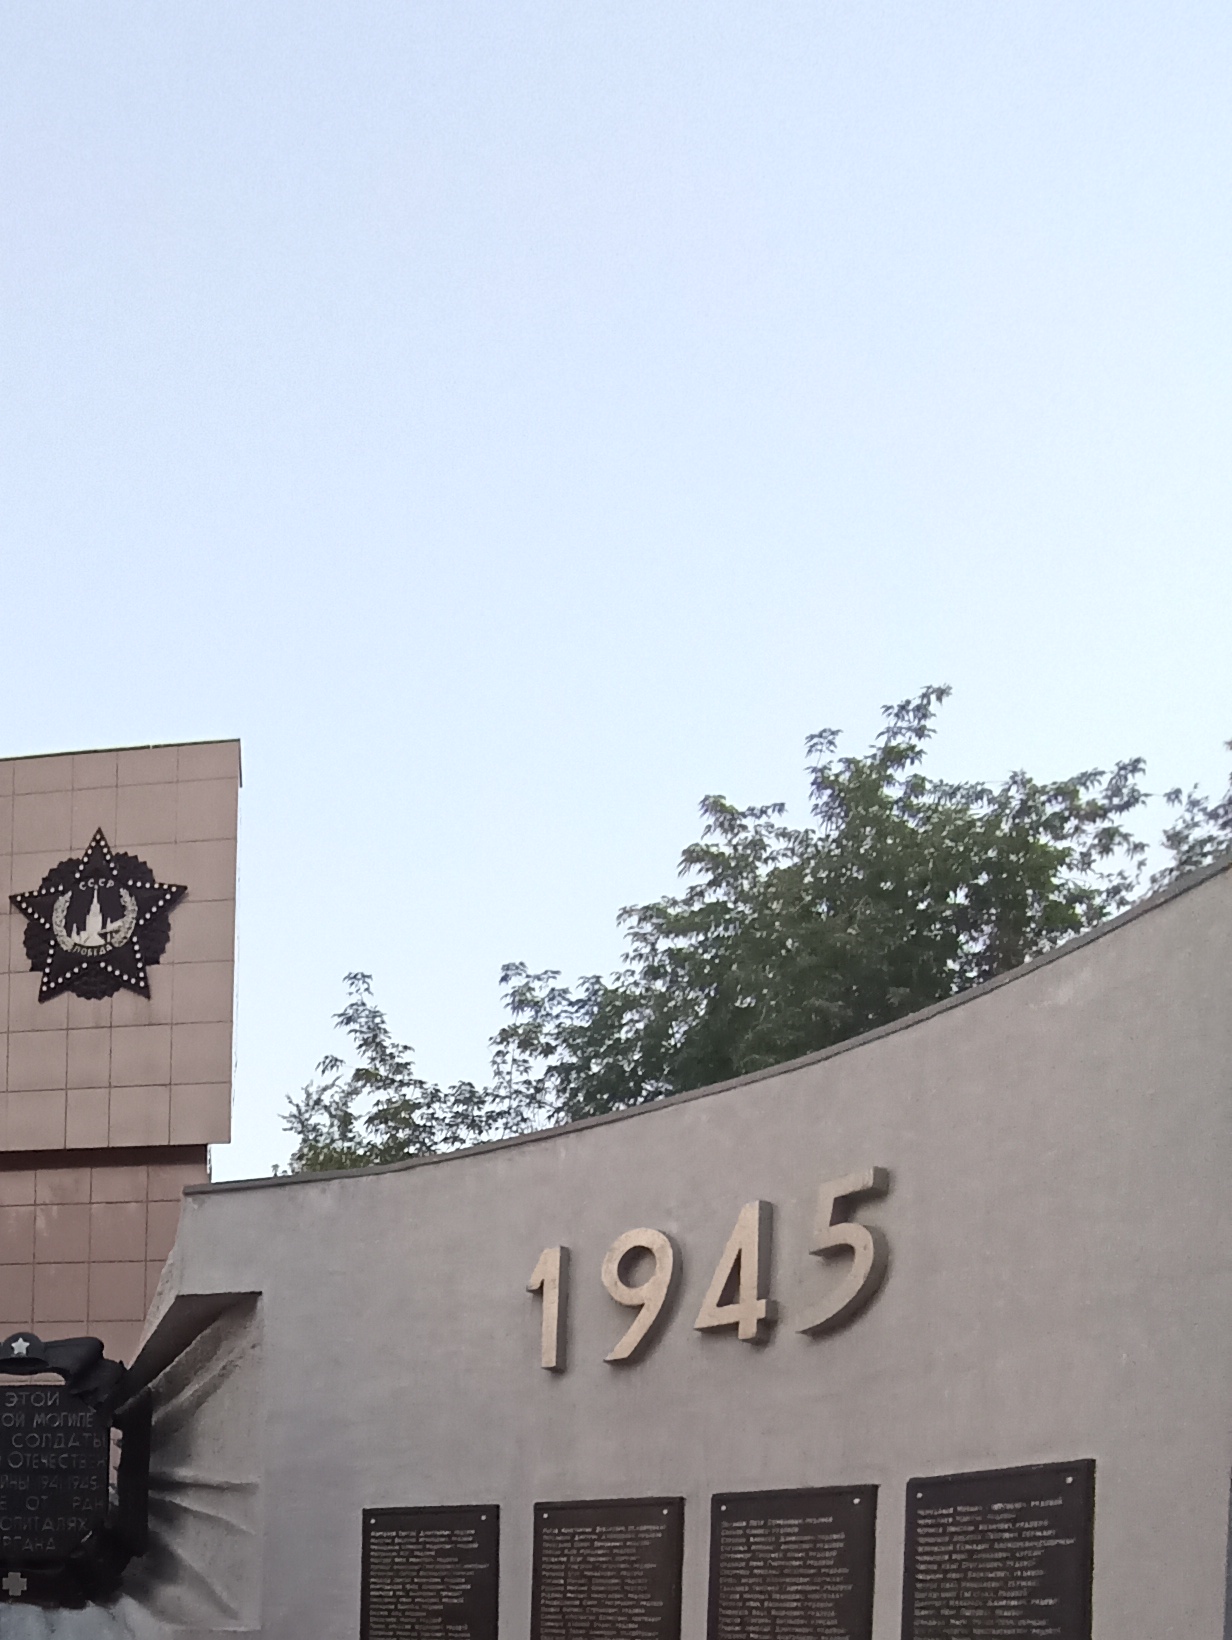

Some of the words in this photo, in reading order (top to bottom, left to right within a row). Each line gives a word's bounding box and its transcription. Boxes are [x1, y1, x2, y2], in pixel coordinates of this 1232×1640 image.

[79, 877, 115, 891] СССР
[73, 944, 113, 957] ПОБЕДА
[526, 1166, 890, 1373] 1945
[33, 1412, 93, 1428] МОГИЛЕ
[12, 1433, 105, 1448] СОЛДАТЫ
